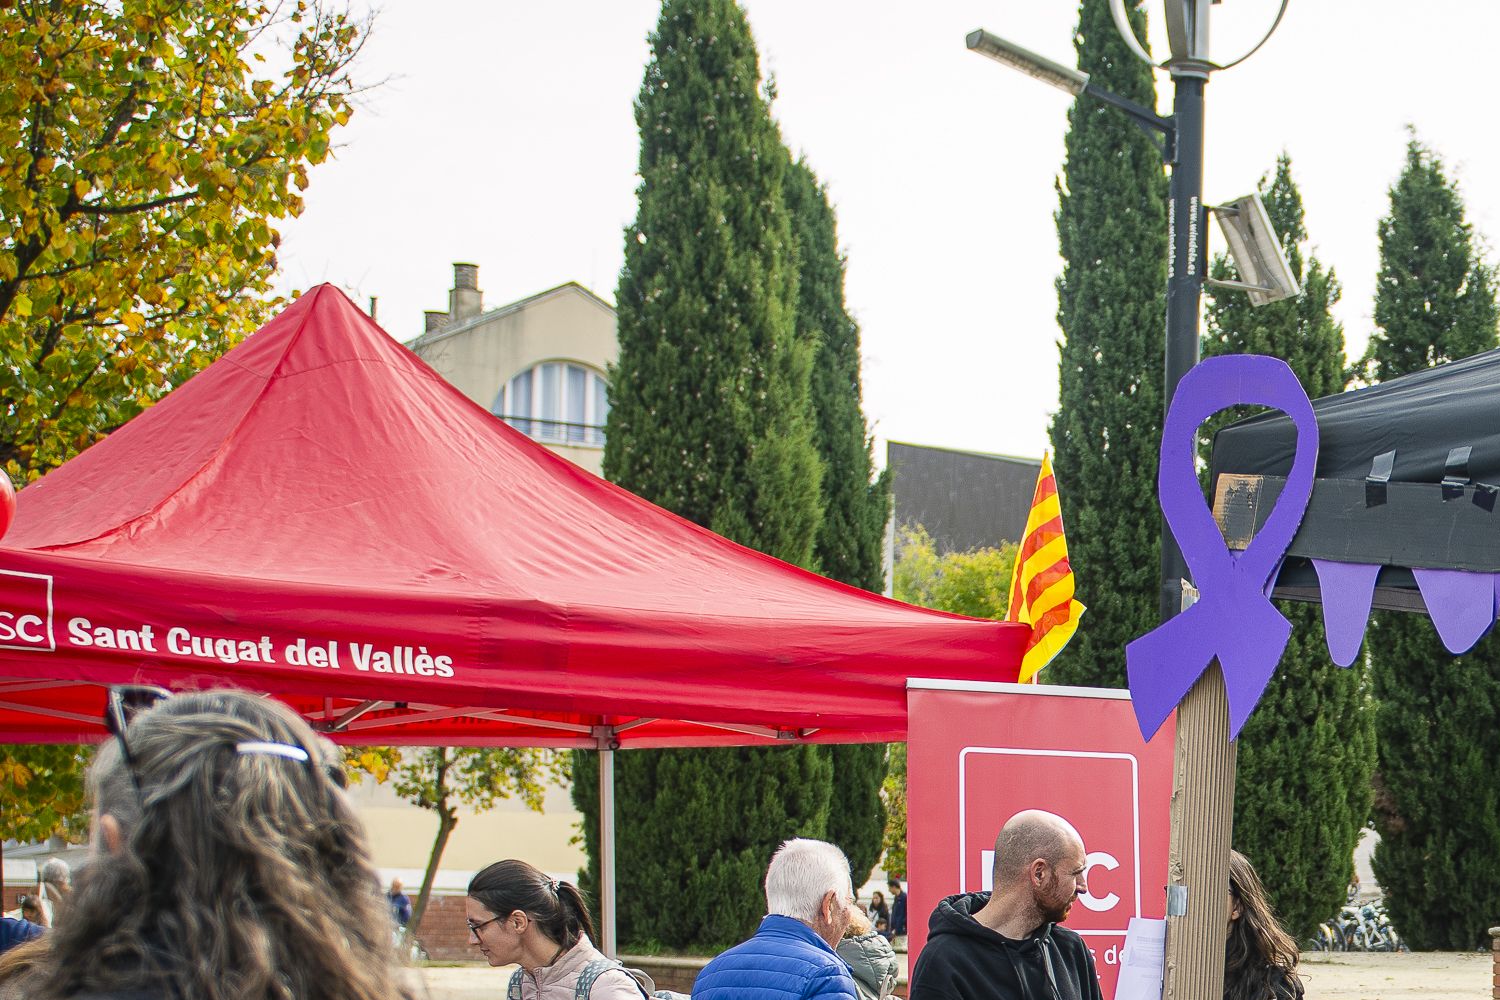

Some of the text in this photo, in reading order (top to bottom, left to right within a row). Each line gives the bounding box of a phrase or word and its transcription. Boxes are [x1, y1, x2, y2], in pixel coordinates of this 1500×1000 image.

[68, 617, 157, 653] Sant
[166, 627, 276, 664] Cugat
[285, 638, 341, 669] del
[350, 643, 455, 678] Vallès
